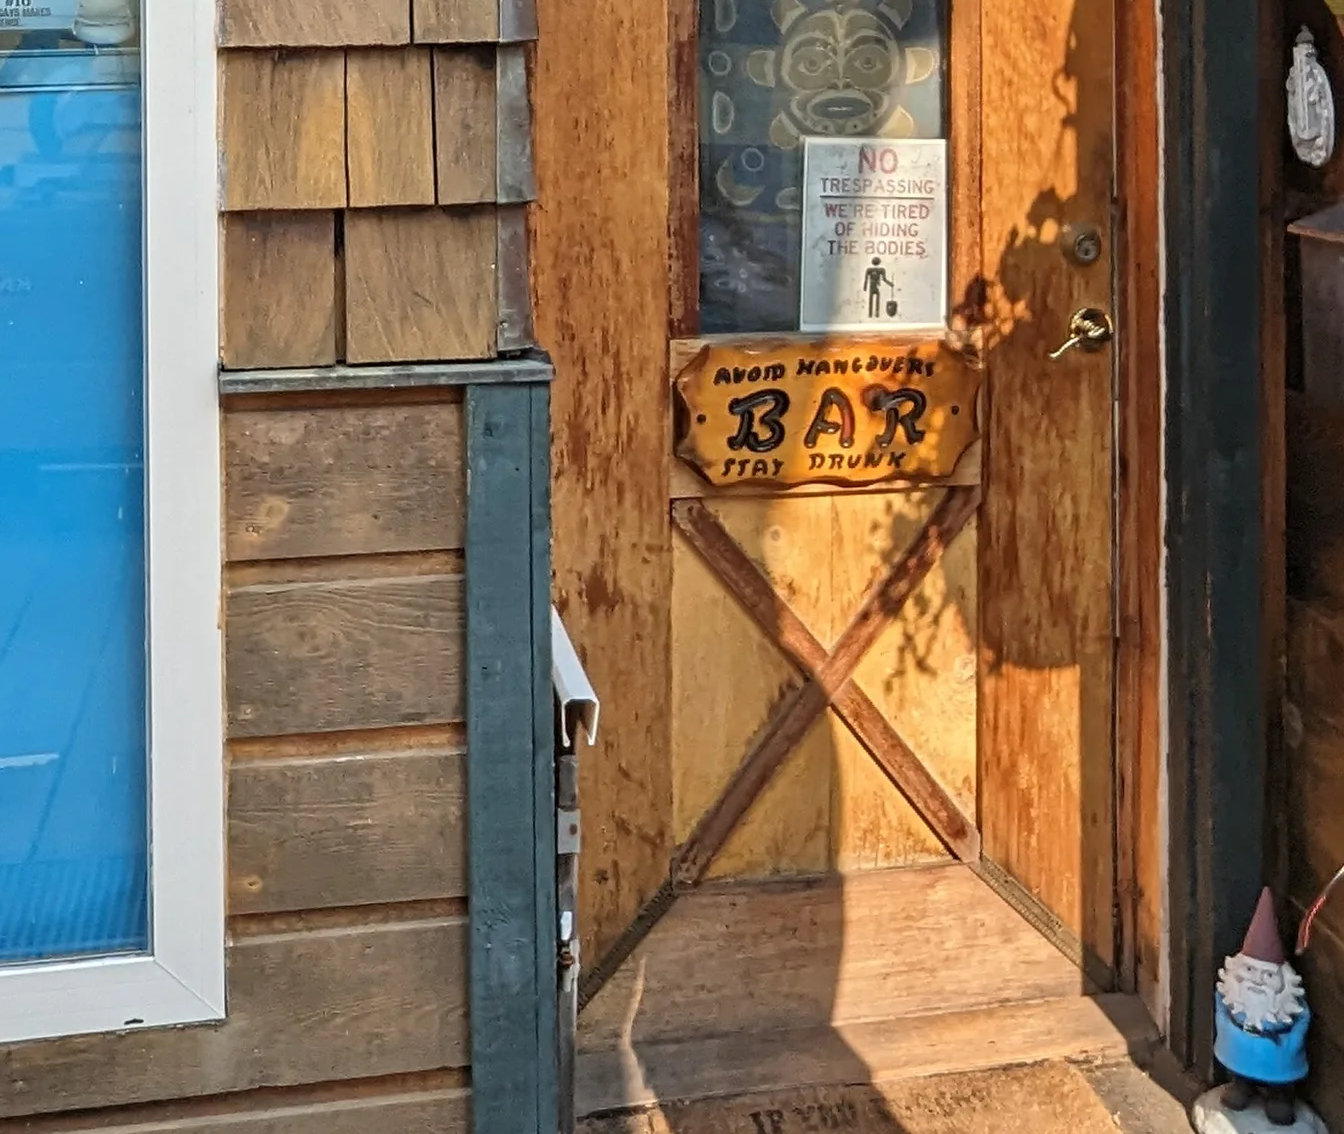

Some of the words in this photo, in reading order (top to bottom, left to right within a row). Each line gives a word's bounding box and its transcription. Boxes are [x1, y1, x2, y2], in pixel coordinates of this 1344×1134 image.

[858, 146, 899, 175] NO
[820, 177, 935, 194] TRESPASSING
[824, 203, 875, 219] WE'RE
[882, 204, 931, 220] TIRED
[834, 222, 856, 237] OF
[862, 222, 919, 237] HIDING
[827, 240, 859, 256] THE
[864, 241, 927, 256] BODIES
[714, 363, 786, 385] AVOID
[728, 384, 927, 452] BAR
[721, 457, 785, 477] STAY
[808, 451, 907, 472] DRUNK
